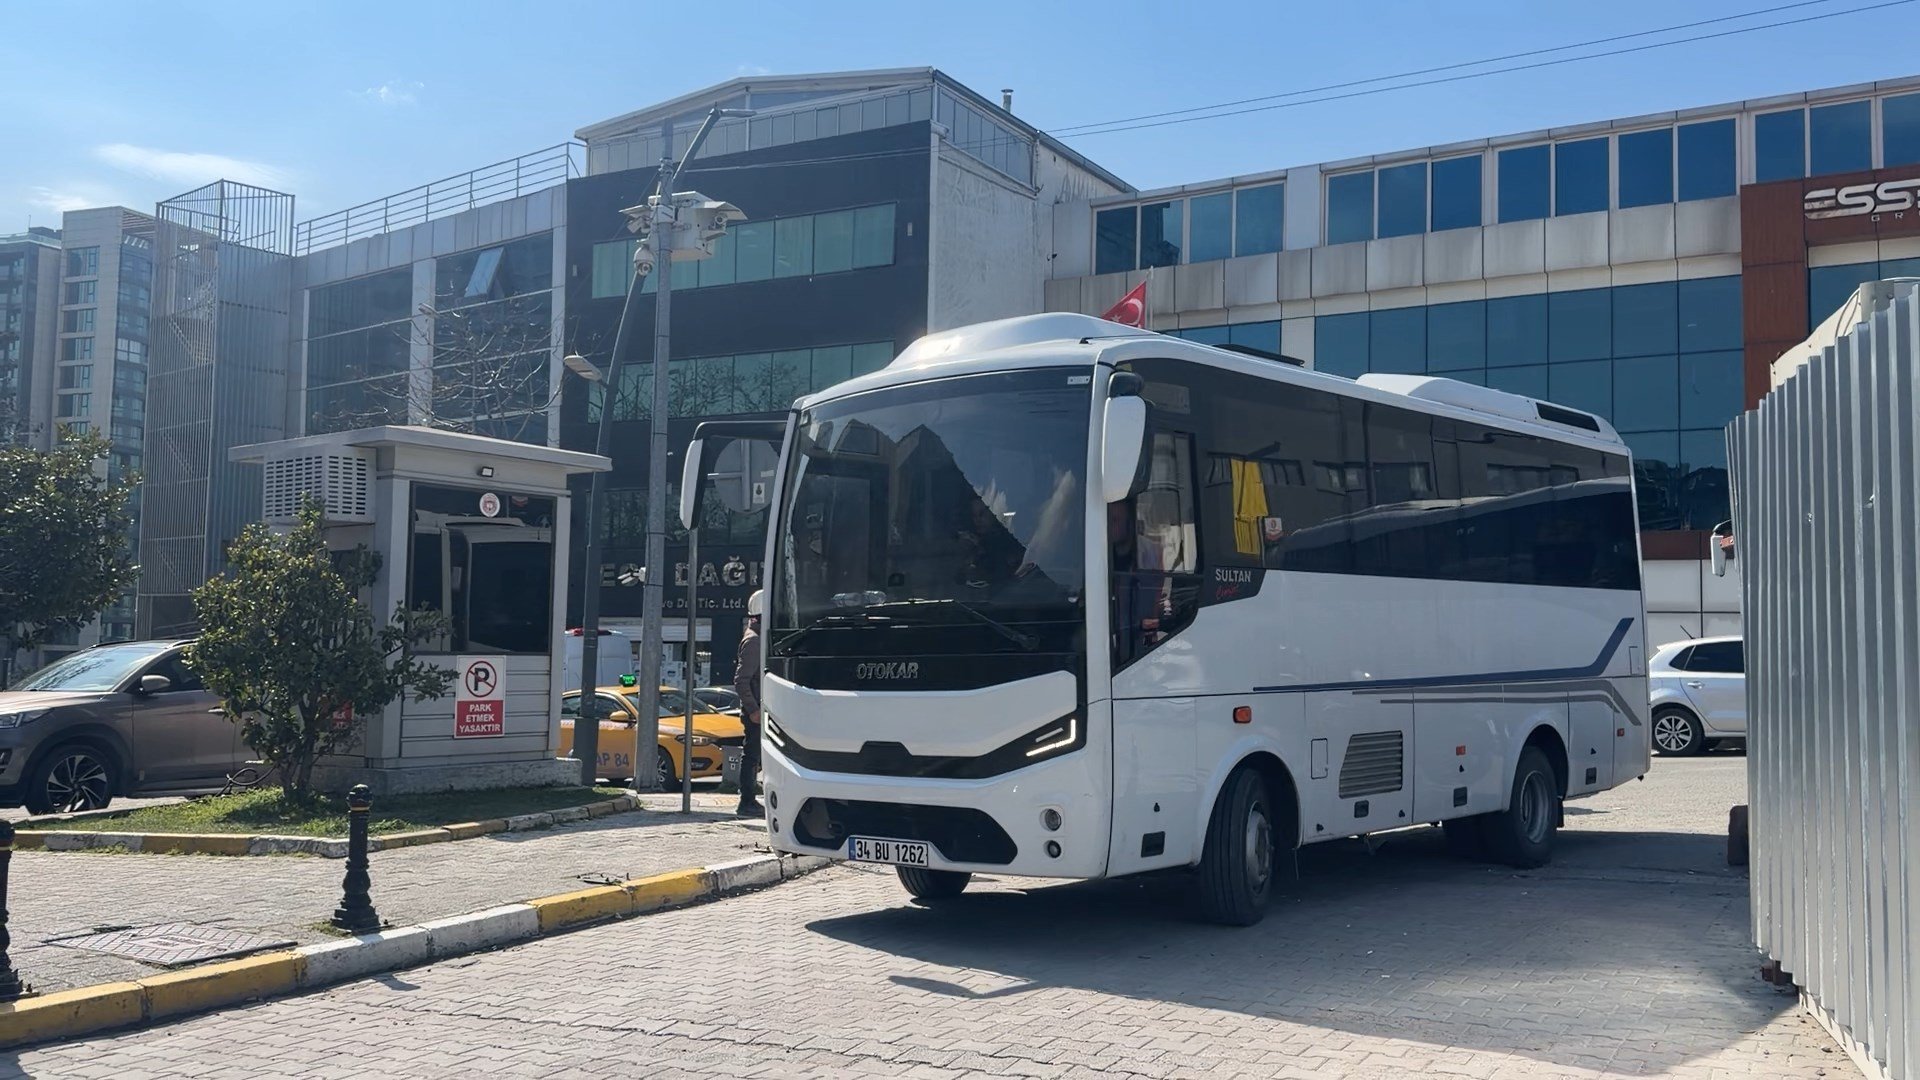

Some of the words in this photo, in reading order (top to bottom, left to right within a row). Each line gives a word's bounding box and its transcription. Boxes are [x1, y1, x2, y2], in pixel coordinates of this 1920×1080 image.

[1804, 178, 1920, 220] ESS
[675, 555, 765, 587] DAĞI
[1215, 568, 1251, 582] SULTAN
[722, 597, 745, 608] Ltd.
[856, 662, 919, 679] OTOKAR
[469, 704, 492, 712] PARK
[465, 714, 495, 722] ETMEK
[459, 724, 501, 733] YASAKTIR
[614, 752, 629, 767] 84
[856, 840, 870, 859] 34
[875, 842, 889, 860] BU
[895, 844, 924, 864] 1262
